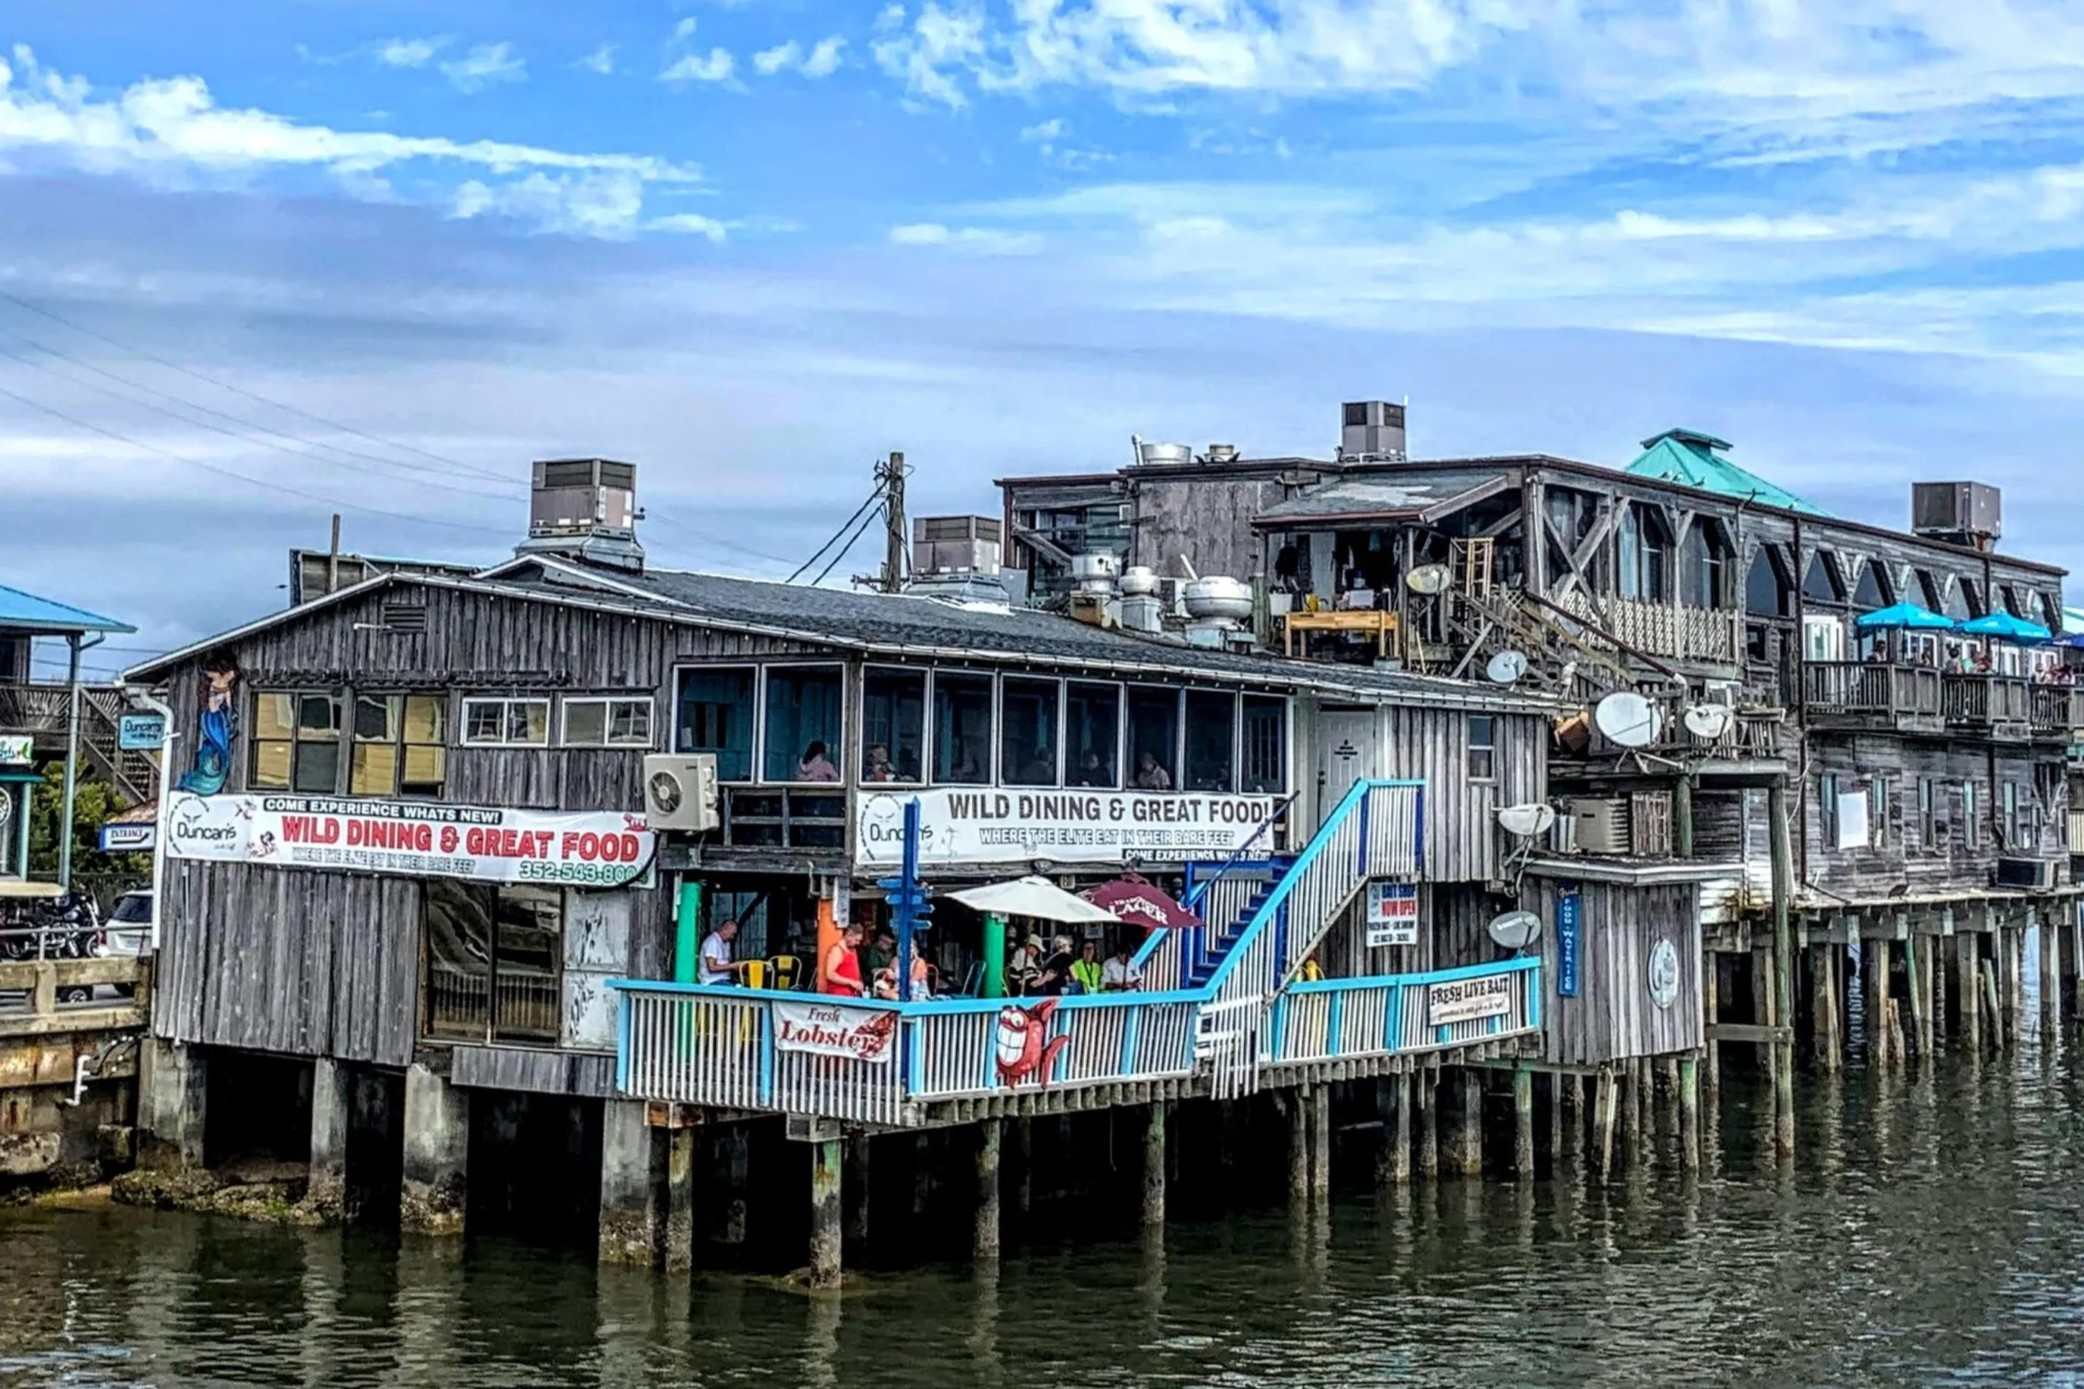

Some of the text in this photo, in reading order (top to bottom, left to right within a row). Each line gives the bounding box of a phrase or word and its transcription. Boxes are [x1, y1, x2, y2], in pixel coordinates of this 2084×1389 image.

[266, 799, 500, 824] COME EXPERIENCE WHATS NEW!
[948, 794, 1269, 824] WILD DINING & GREAT FOOD!
[111, 829, 143, 838] ENTRANCE
[281, 815, 640, 863] WILD DINING & GREAT FOOD
[979, 827, 1235, 847] WHERE THE ELITE EAT IN THEIR BARE FEET
[1155, 850, 1216, 862] EXPERIENCE
[1431, 977, 1509, 1006] FRESH LIVE BAIT
[807, 1007, 841, 1022] Fresh
[781, 1020, 872, 1049] Lobster
